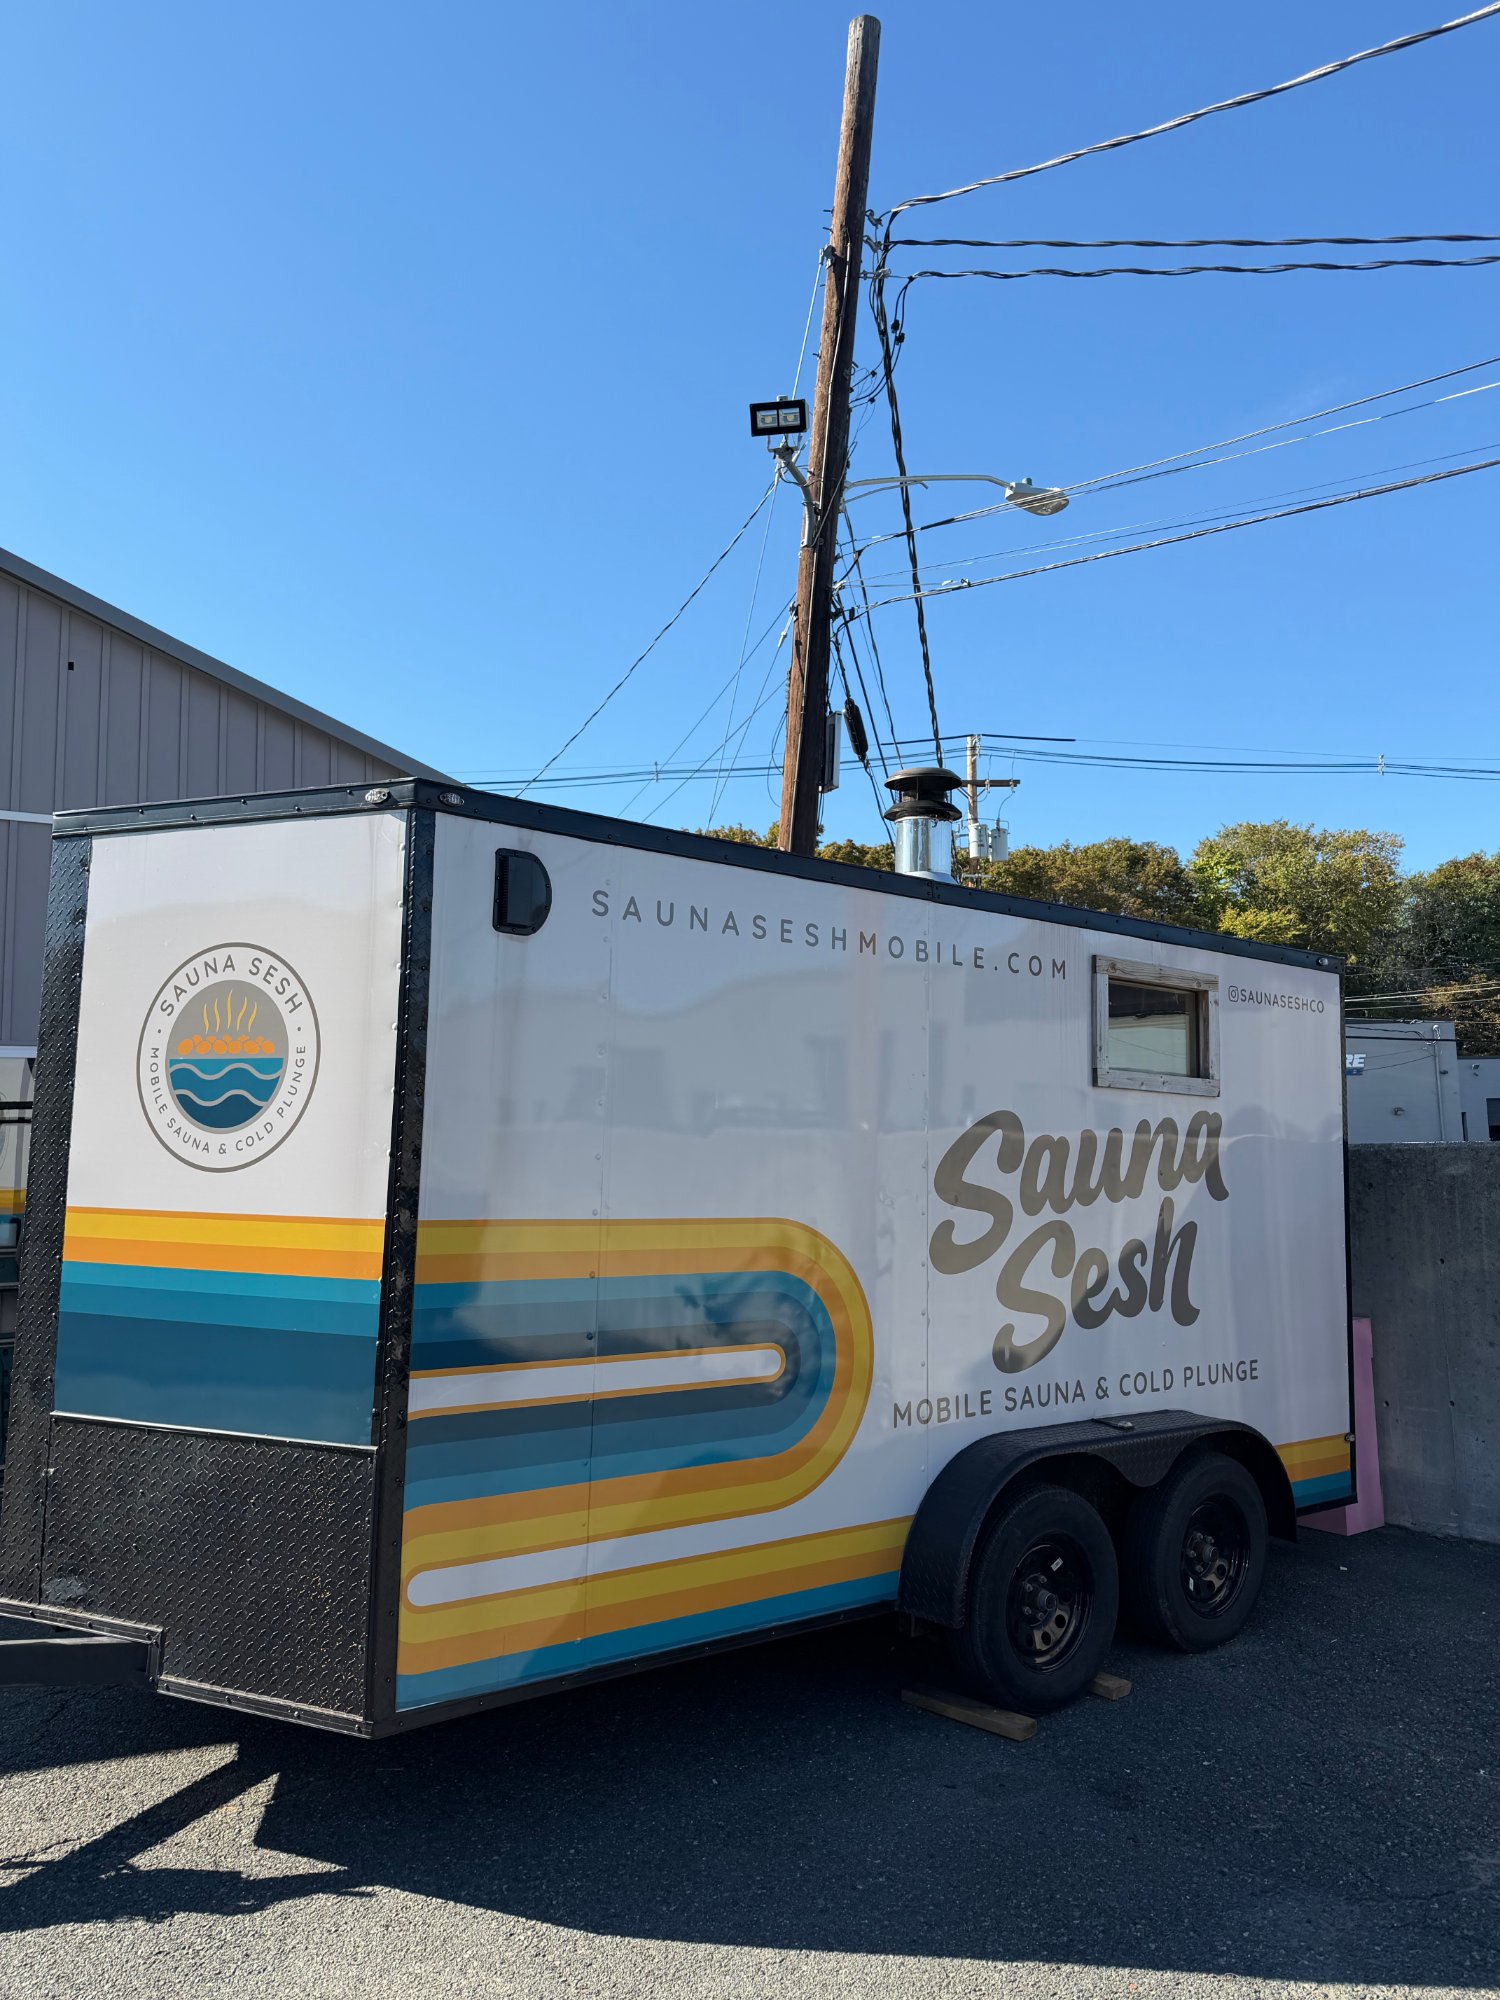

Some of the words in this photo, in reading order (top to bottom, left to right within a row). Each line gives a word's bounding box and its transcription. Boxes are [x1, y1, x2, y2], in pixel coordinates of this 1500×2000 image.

[591, 889, 1067, 980] SAUNASESHMOBILE.COM
[160, 954, 236, 1017] SAUNA
[248, 957, 303, 1014] SESH
[149, 1047, 169, 1114] MOBILE
[166, 1117, 210, 1154] SAUNA
[218, 1143, 227, 1155] &
[235, 1121, 274, 1152] COLD
[276, 1045, 306, 1118] PLUNGE
[929, 1110, 1229, 1275] Sauna
[992, 1196, 1200, 1374] Sesh
[893, 1389, 992, 1429] MOBILE
[1004, 1379, 1086, 1412] SAUNA
[1095, 1376, 1110, 1400] &
[1119, 1368, 1174, 1397] COLD
[1184, 1359, 1259, 1387] PLUNGE
